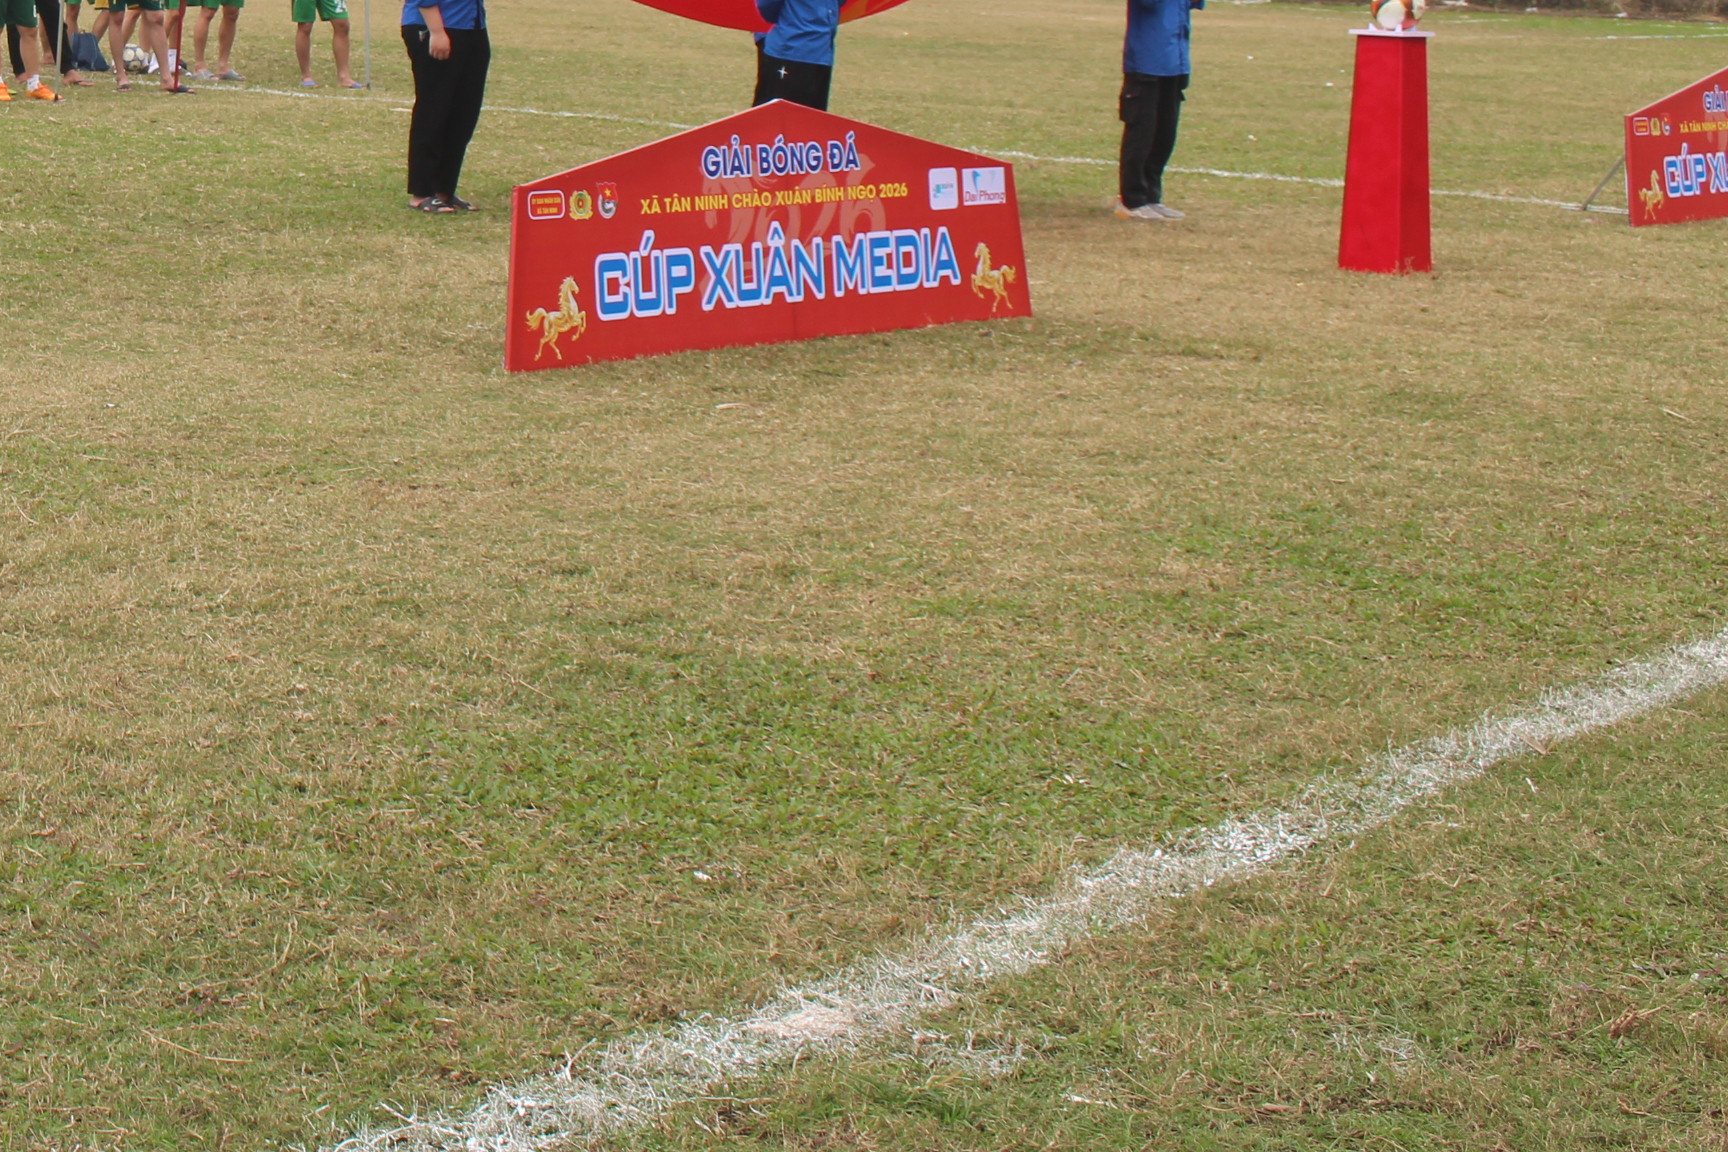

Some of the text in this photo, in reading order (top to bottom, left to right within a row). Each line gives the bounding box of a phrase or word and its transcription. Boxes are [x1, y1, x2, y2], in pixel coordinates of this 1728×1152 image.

[702, 130, 861, 179] GIẢI BÓNG ĐÁ
[1663, 142, 1706, 198] CÚP
[640, 182, 908, 215] XÃ TÂN NINH CHÀO XUÂN BÍNH NGỌ 2026
[979, 189, 1005, 204] Phong
[595, 221, 962, 322] CÚP XUÂN MEDIA
